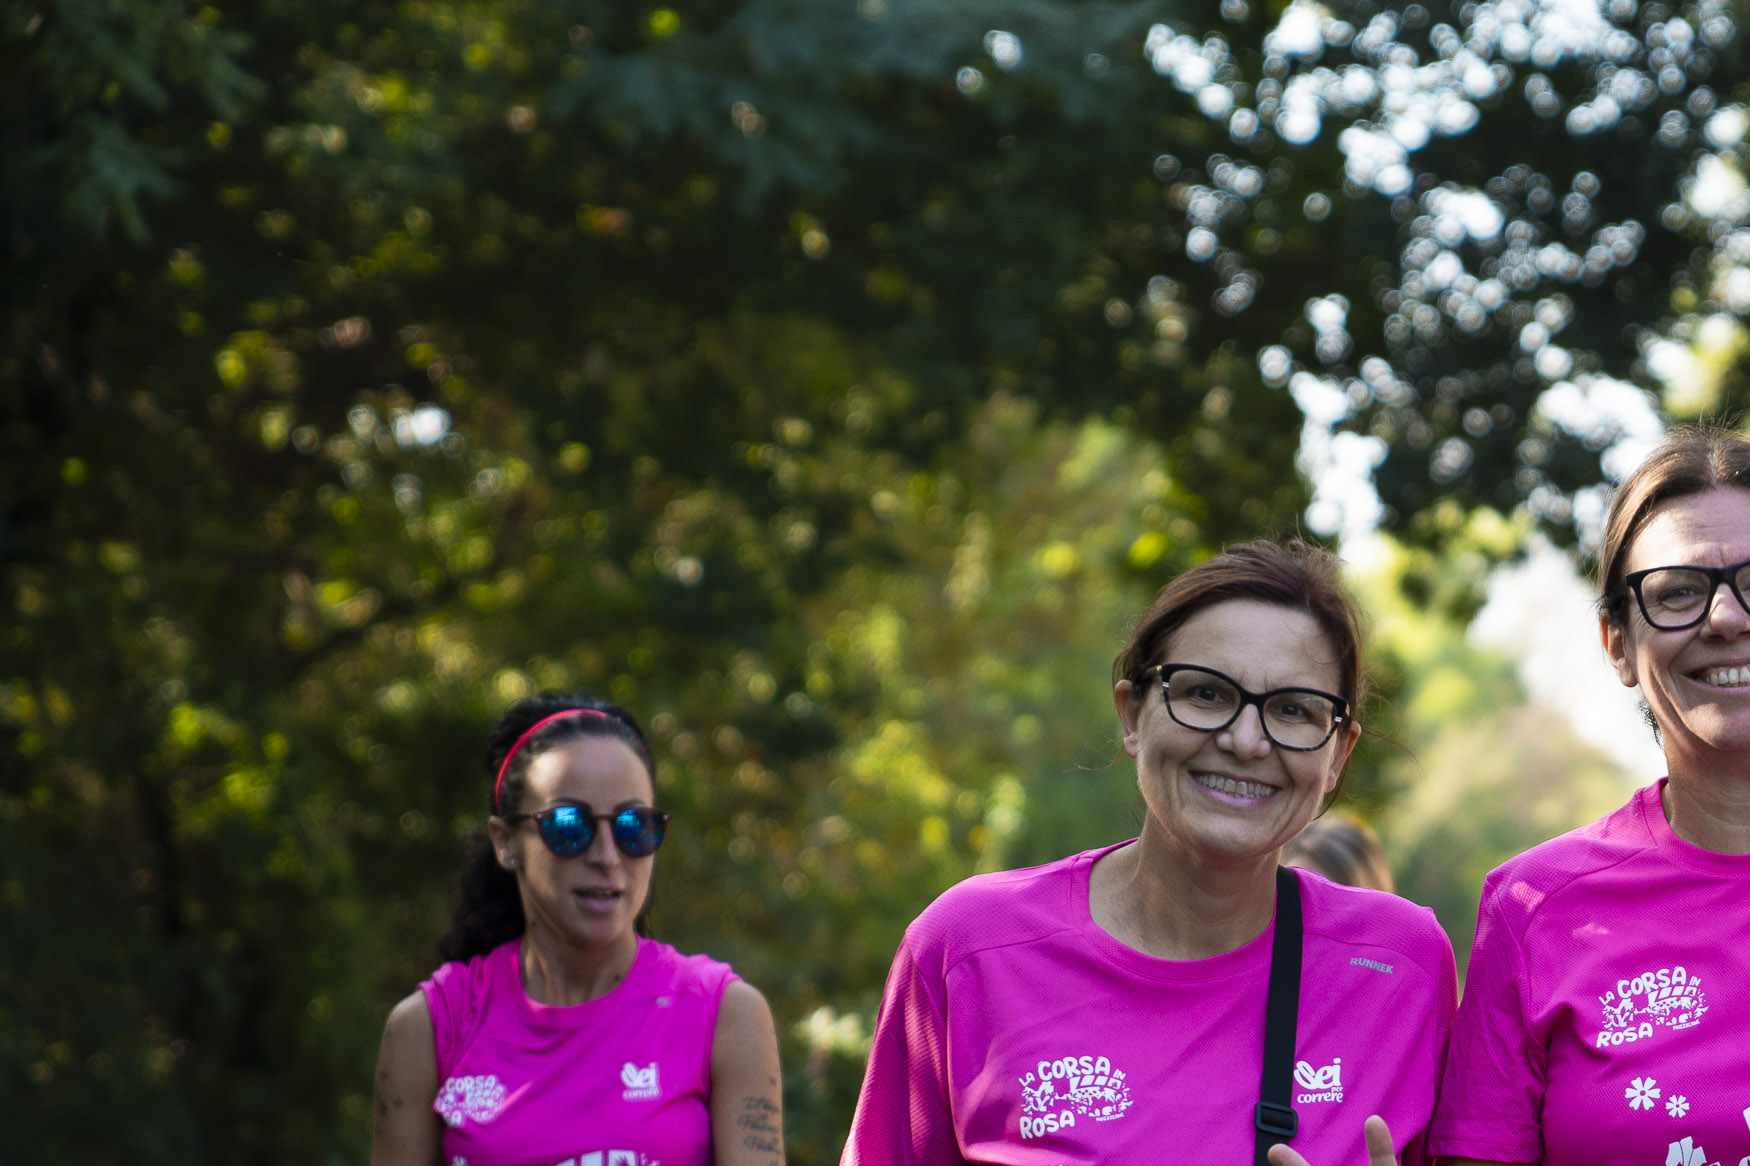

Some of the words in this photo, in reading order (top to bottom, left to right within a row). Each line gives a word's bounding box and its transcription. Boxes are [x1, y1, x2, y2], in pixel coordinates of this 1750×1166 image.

[1350, 957, 1394, 975] RUNNEK
[1598, 991, 1615, 1005] LA
[1617, 966, 1687, 999] CORSA
[1689, 976, 1702, 986] IN
[1596, 1022, 1653, 1048] ROSA
[1018, 1072, 1035, 1087] LA
[1037, 1055, 1111, 1081] CORSA
[1113, 1068, 1126, 1080] IN
[1293, 1057, 1342, 1090] Sei
[1297, 1092, 1343, 1103] correre
[1020, 1109, 1075, 1139] ROSA
